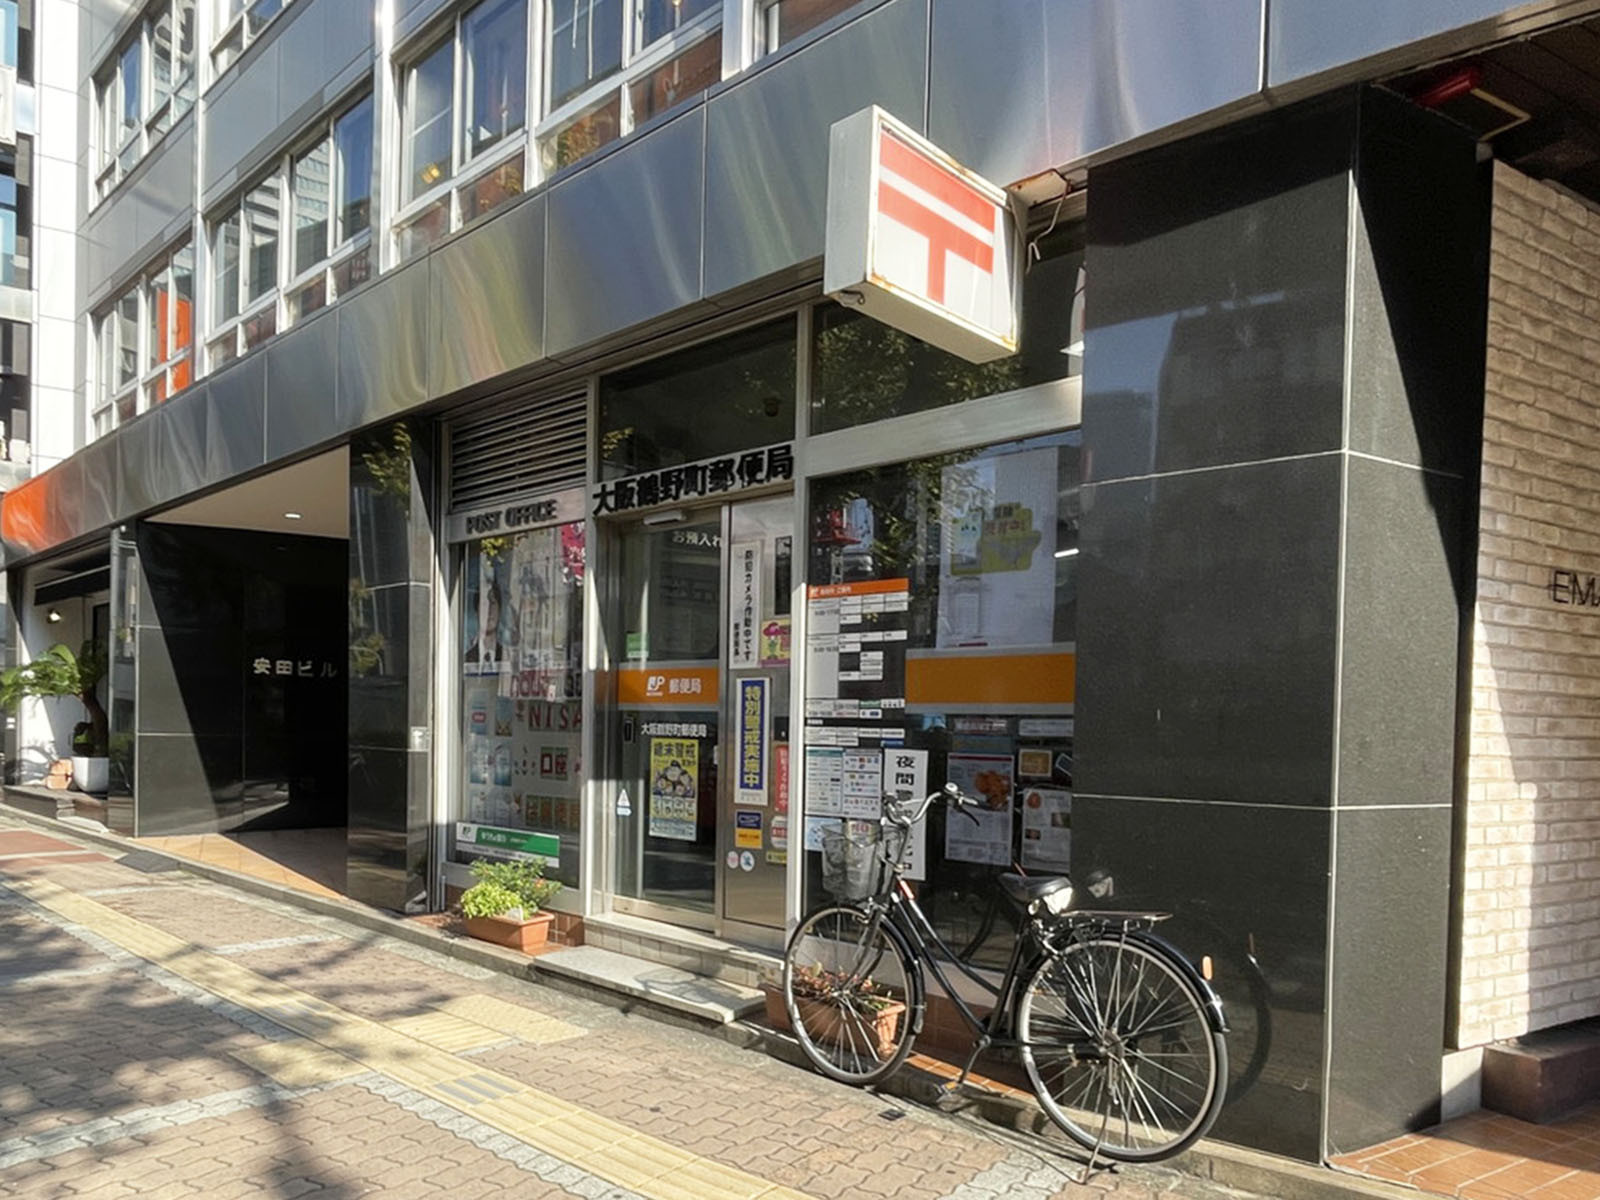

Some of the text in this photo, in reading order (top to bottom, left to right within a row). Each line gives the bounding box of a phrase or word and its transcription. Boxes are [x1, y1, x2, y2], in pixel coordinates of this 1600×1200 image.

[465, 498, 558, 535] POST OFFICE
[253, 657, 337, 678] 安田ビル
[669, 678, 702, 695] 郵便局
[743, 685, 762, 789] 特別警戒実施中
[540, 752, 568, 775] 口座
